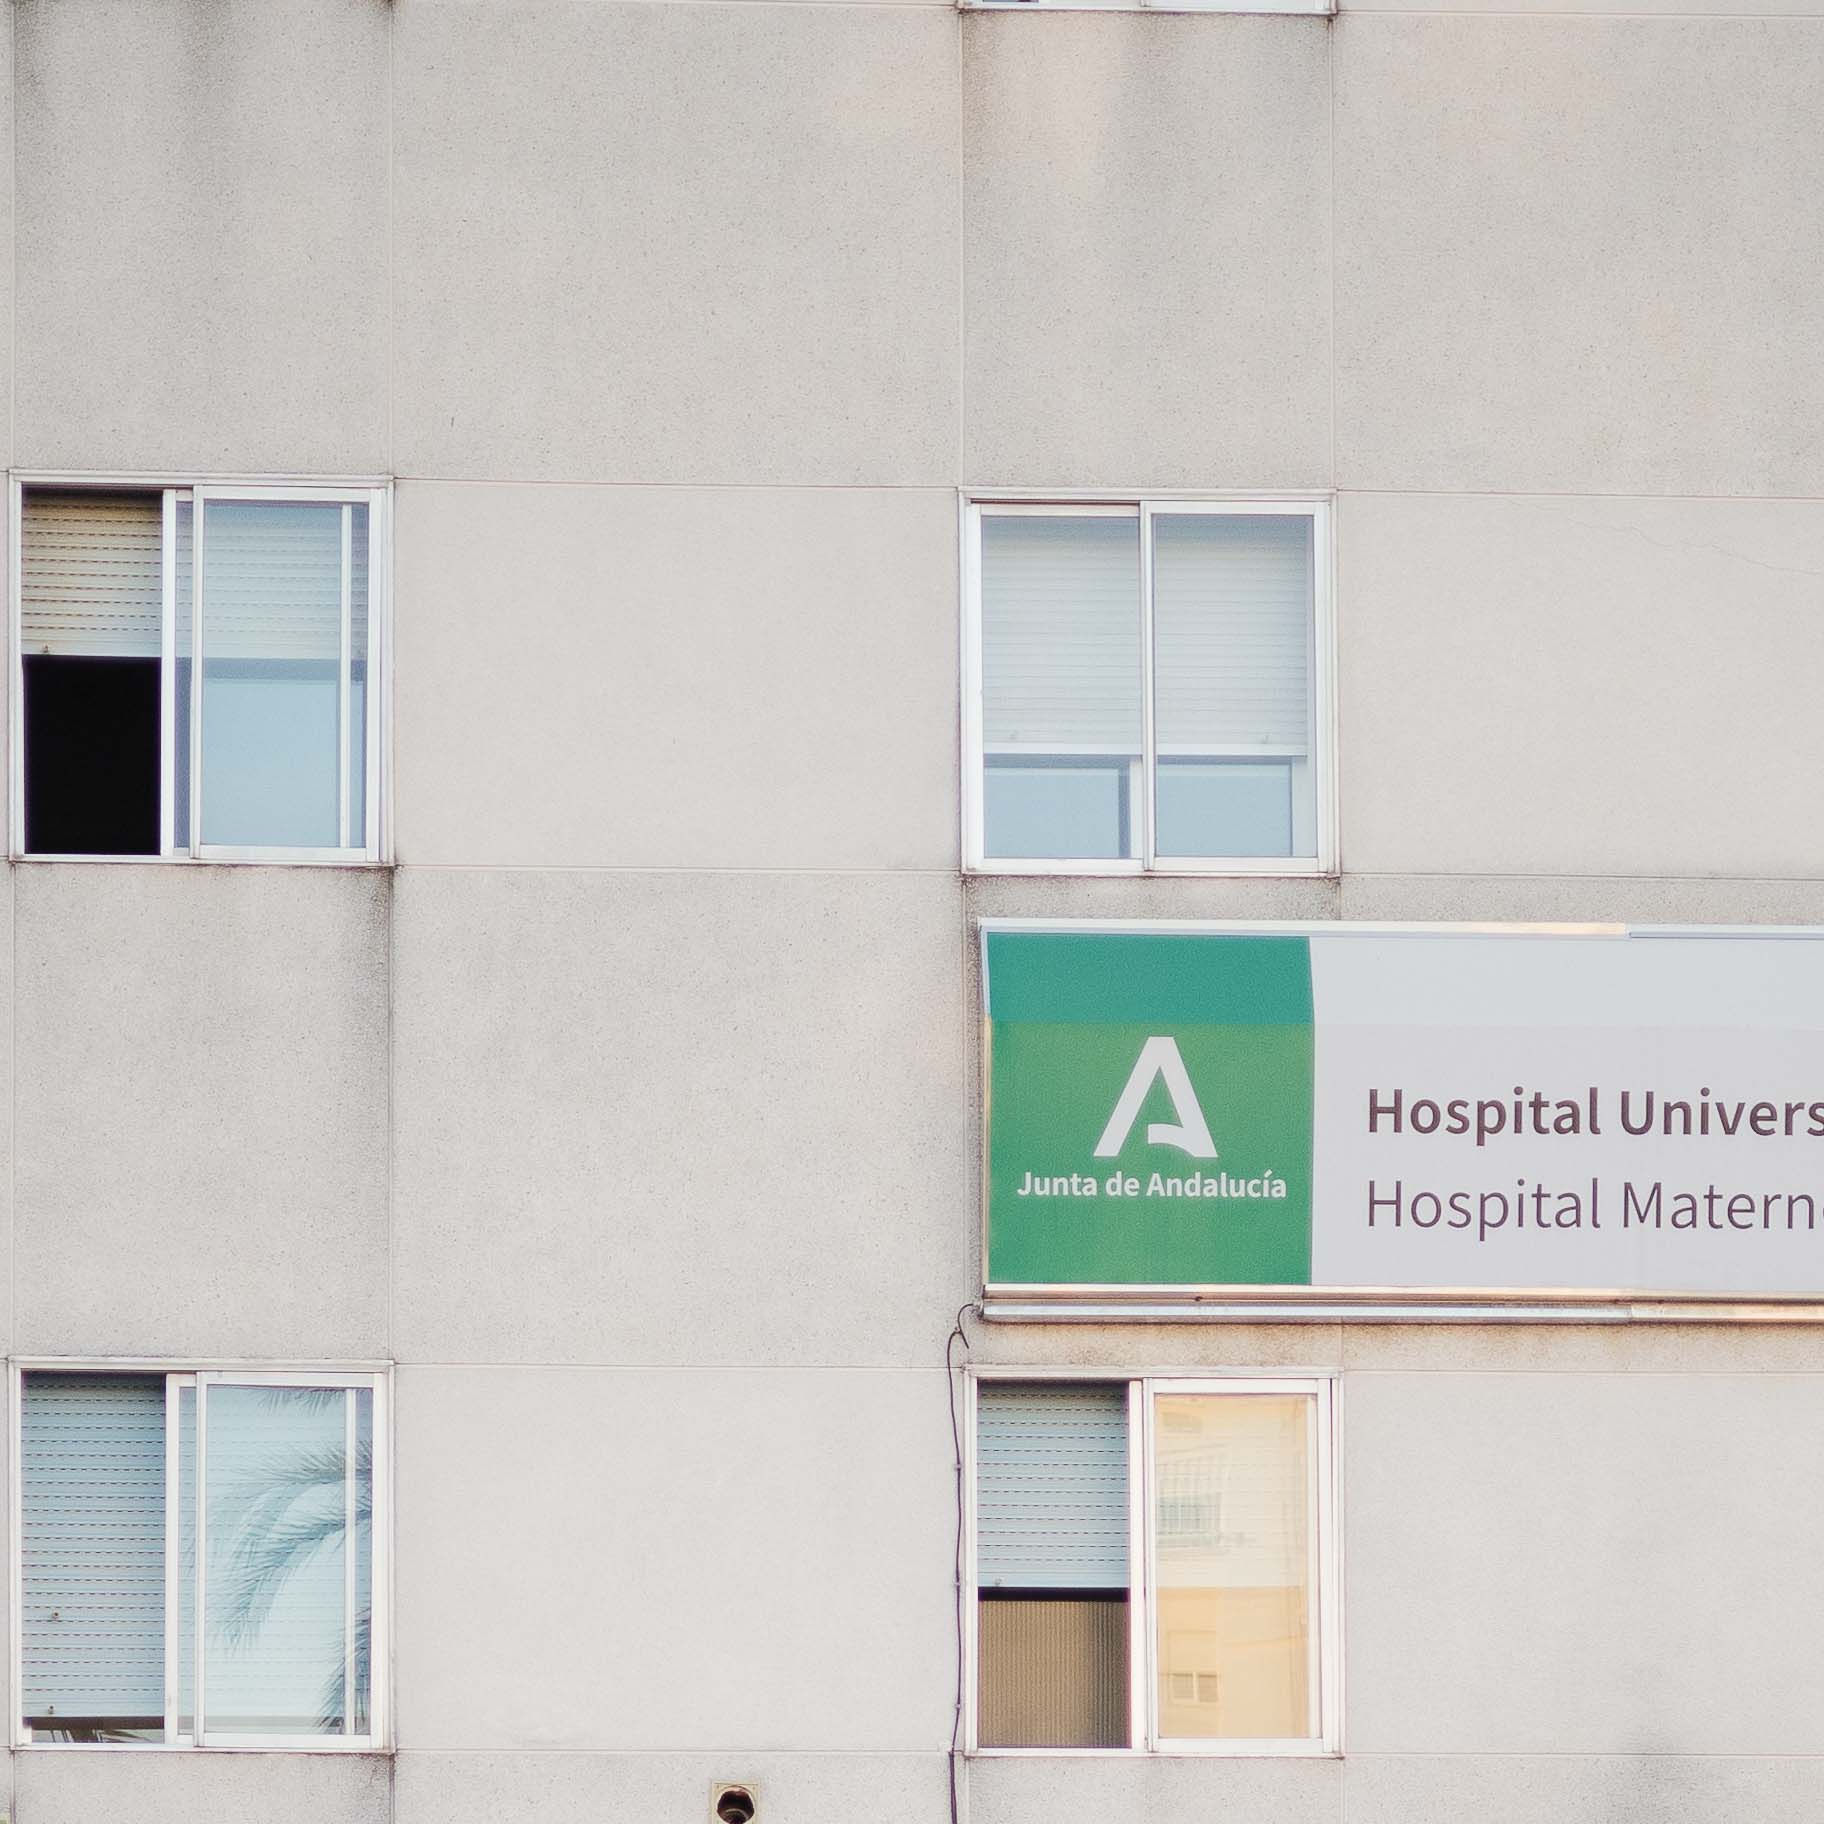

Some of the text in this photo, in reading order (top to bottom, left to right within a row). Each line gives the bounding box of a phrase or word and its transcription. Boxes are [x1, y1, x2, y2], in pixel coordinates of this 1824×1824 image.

[1369, 1086, 1600, 1146] Hospital
[1017, 1169, 1287, 1199] Junta de Andalucía
[1369, 1178, 1600, 1242] Hospital
